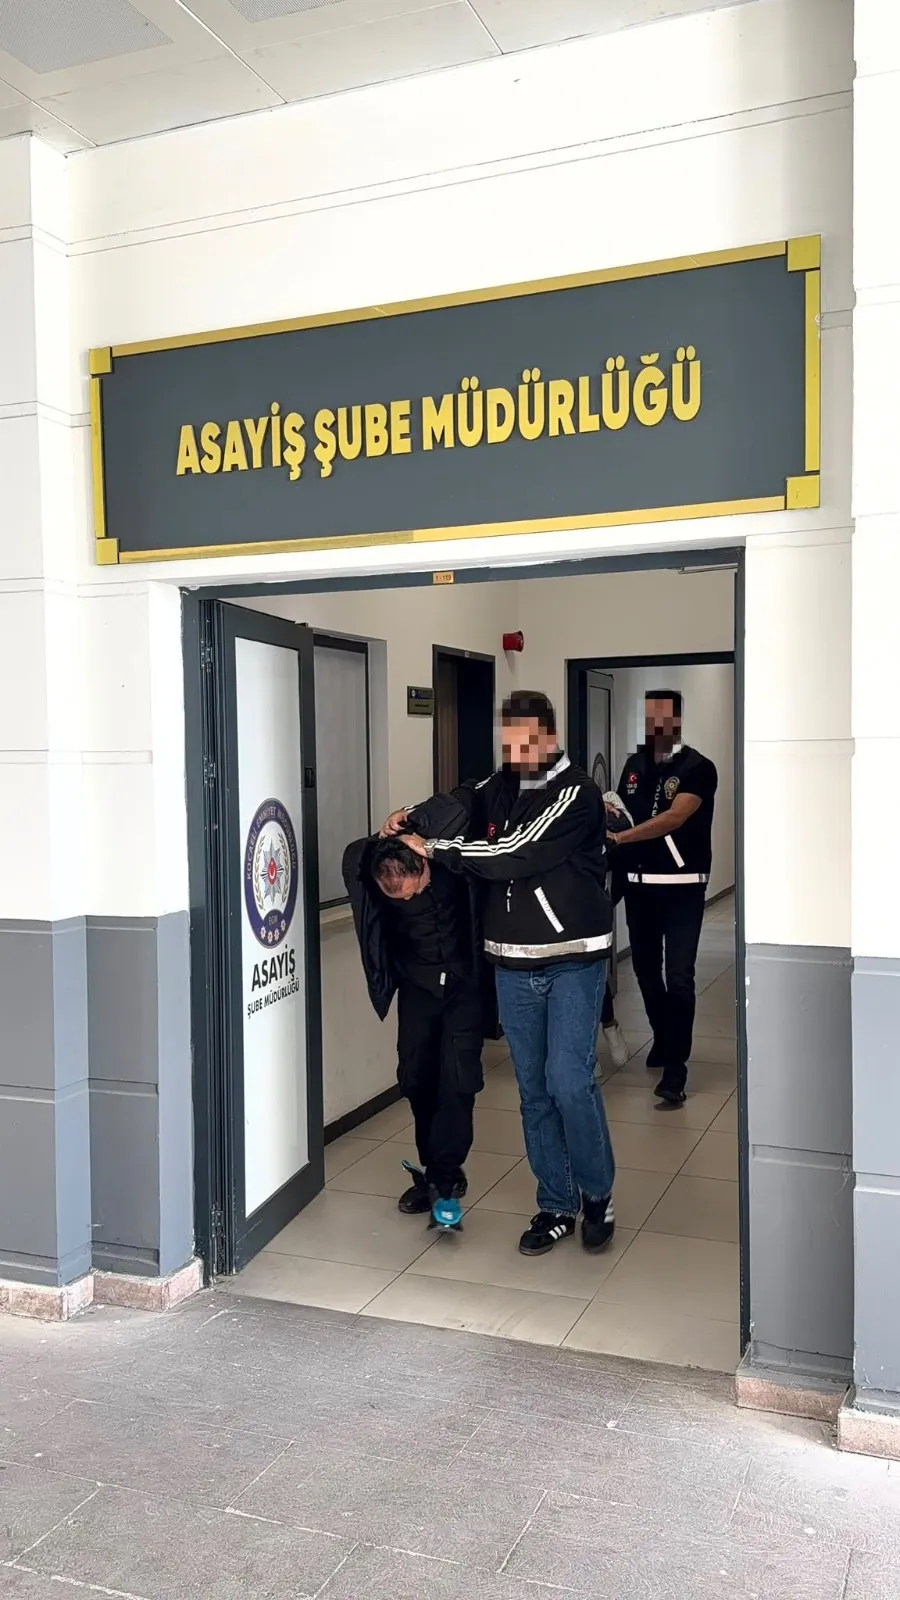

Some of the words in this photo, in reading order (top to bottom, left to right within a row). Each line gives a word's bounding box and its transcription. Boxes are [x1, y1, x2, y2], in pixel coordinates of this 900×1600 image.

[176, 401, 307, 481] ASAYİŞ
[313, 400, 412, 479] ŞUBE
[423, 345, 701, 449] MÜDÜRLÜĞÜ
[251, 944, 296, 992] ASAYİŞ
[247, 998, 263, 1019] ŞUBE
[263, 977, 300, 1008] MÜDÜRLÜĞÜ
